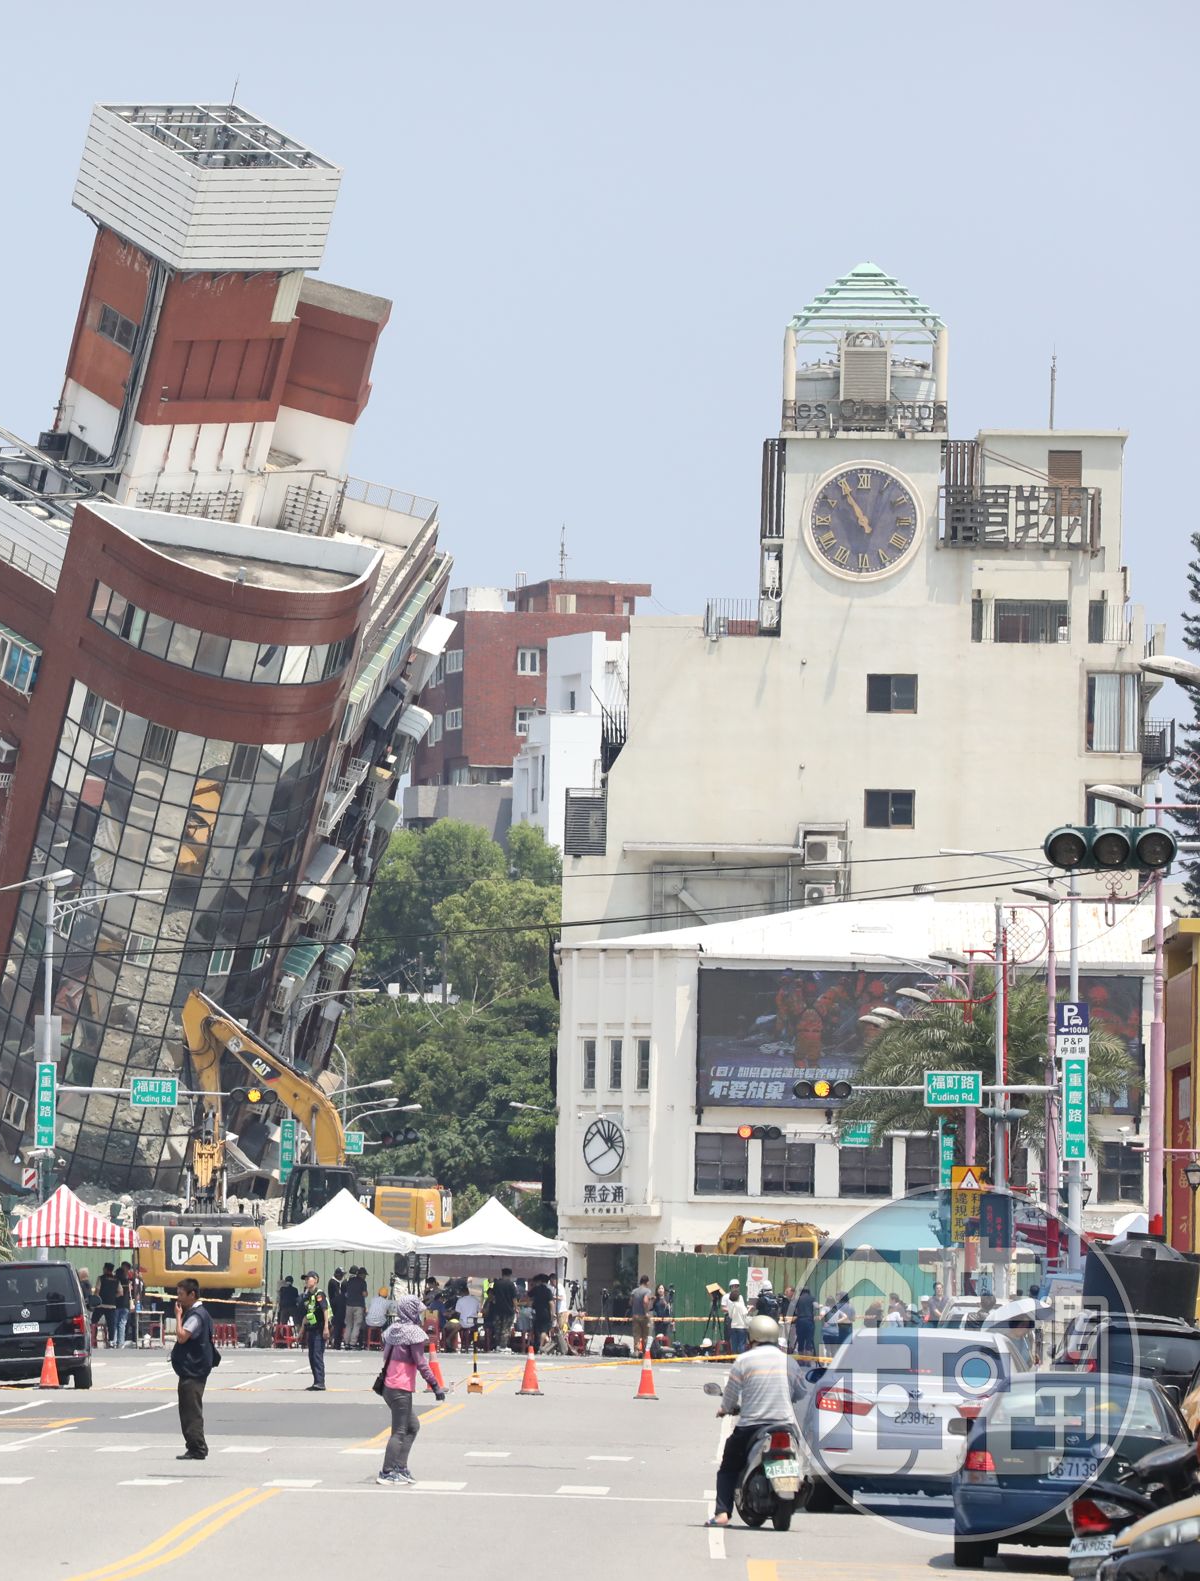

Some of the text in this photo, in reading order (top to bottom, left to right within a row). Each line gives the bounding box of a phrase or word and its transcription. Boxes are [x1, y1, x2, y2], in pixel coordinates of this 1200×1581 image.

[1063, 1004, 1079, 1026] P
[1069, 1026, 1088, 1034] 100M
[1060, 1046, 1087, 1055] 停車場
[252, 1057, 272, 1077] CAT
[136, 1080, 172, 1092] 福町路
[709, 1080, 786, 1100] 不要放棄
[932, 1075, 975, 1090] 福町路
[931, 1092, 975, 1103] Fuding Rd.
[1068, 1072, 1083, 1123] 重慶路
[359, 1195, 372, 1209] AT
[584, 1184, 624, 1203] 黑金通
[171, 1233, 223, 1266] CAT
